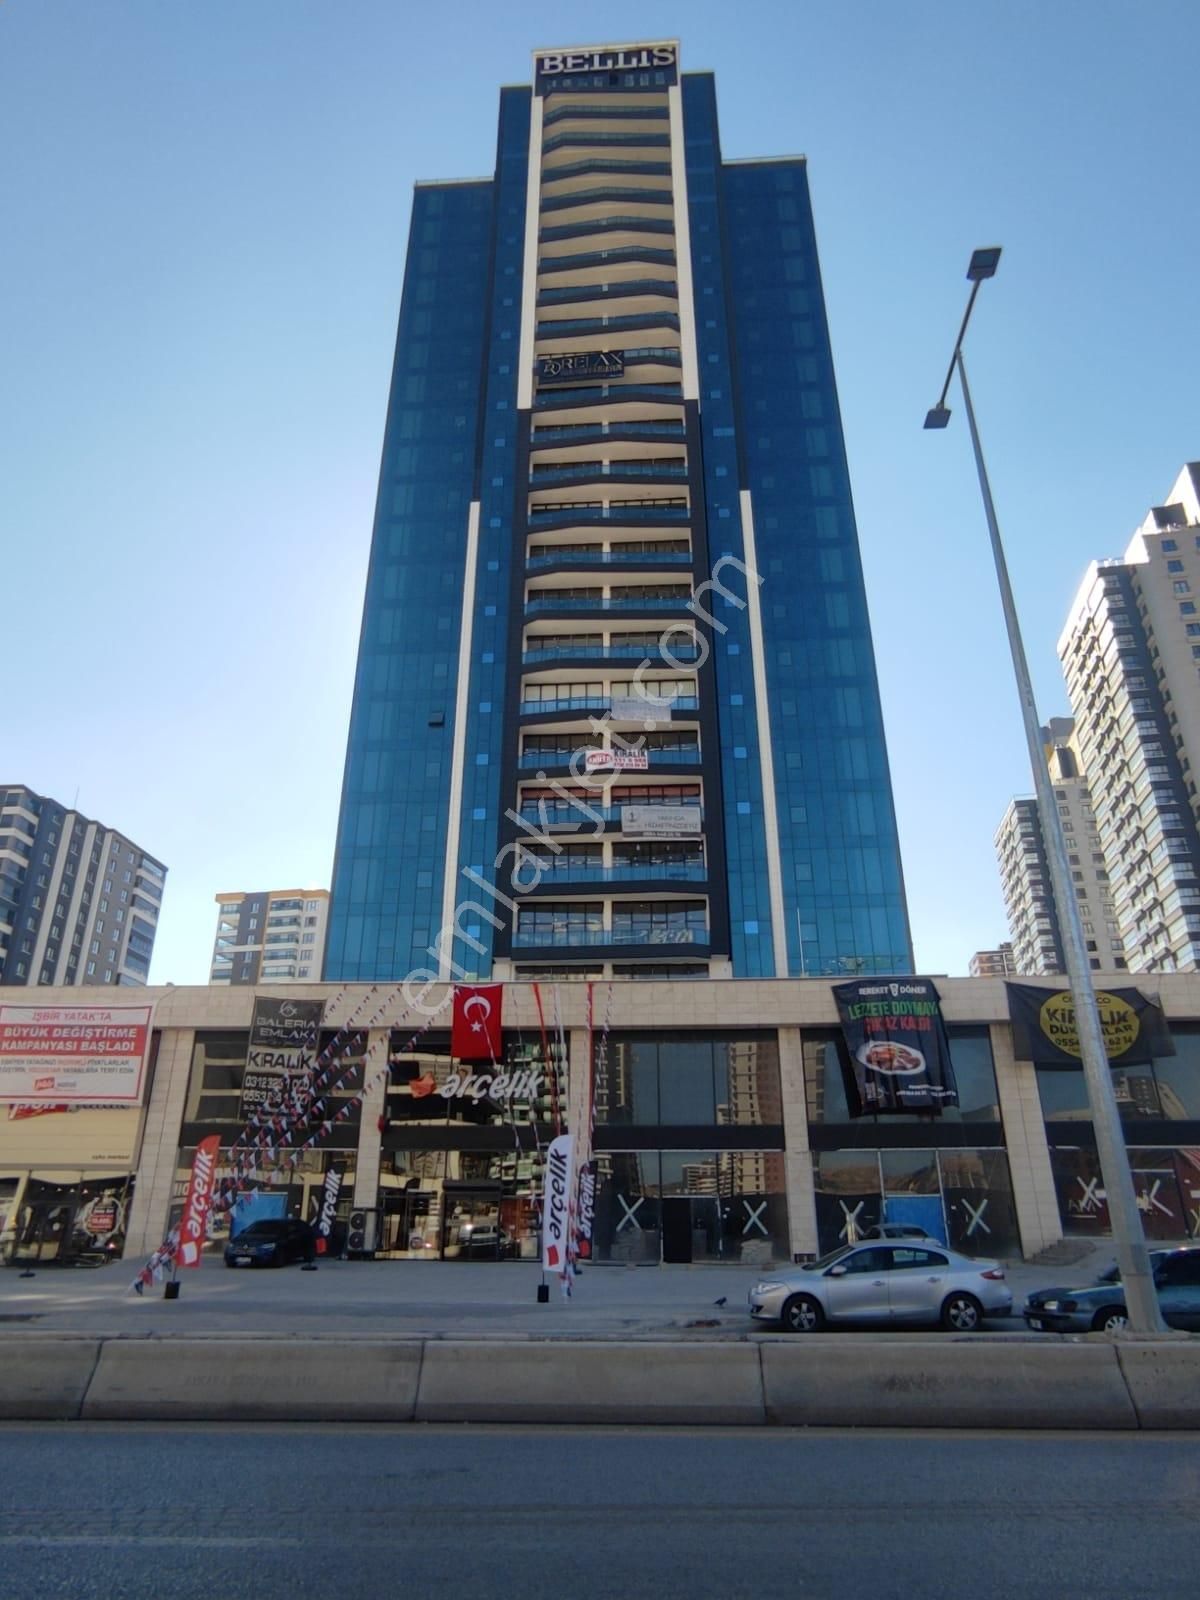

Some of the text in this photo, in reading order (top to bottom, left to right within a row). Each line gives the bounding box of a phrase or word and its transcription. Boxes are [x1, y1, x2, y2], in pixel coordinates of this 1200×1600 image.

[540, 46, 675, 75] BELLIS
[562, 352, 623, 369] RELAX
[1, 1040, 135, 1053] KAMPANYASI BAŞLADI
[3, 1026, 137, 1040] BÜYÜK DEĞİŞTİRME
[259, 1027, 310, 1039] EMLAK
[440, 1070, 544, 1105] arçelik
[186, 1149, 214, 1239] arçelik
[318, 1168, 343, 1237] arçelik
[549, 1148, 567, 1240] arçelik
[580, 1173, 595, 1239] arçelik
